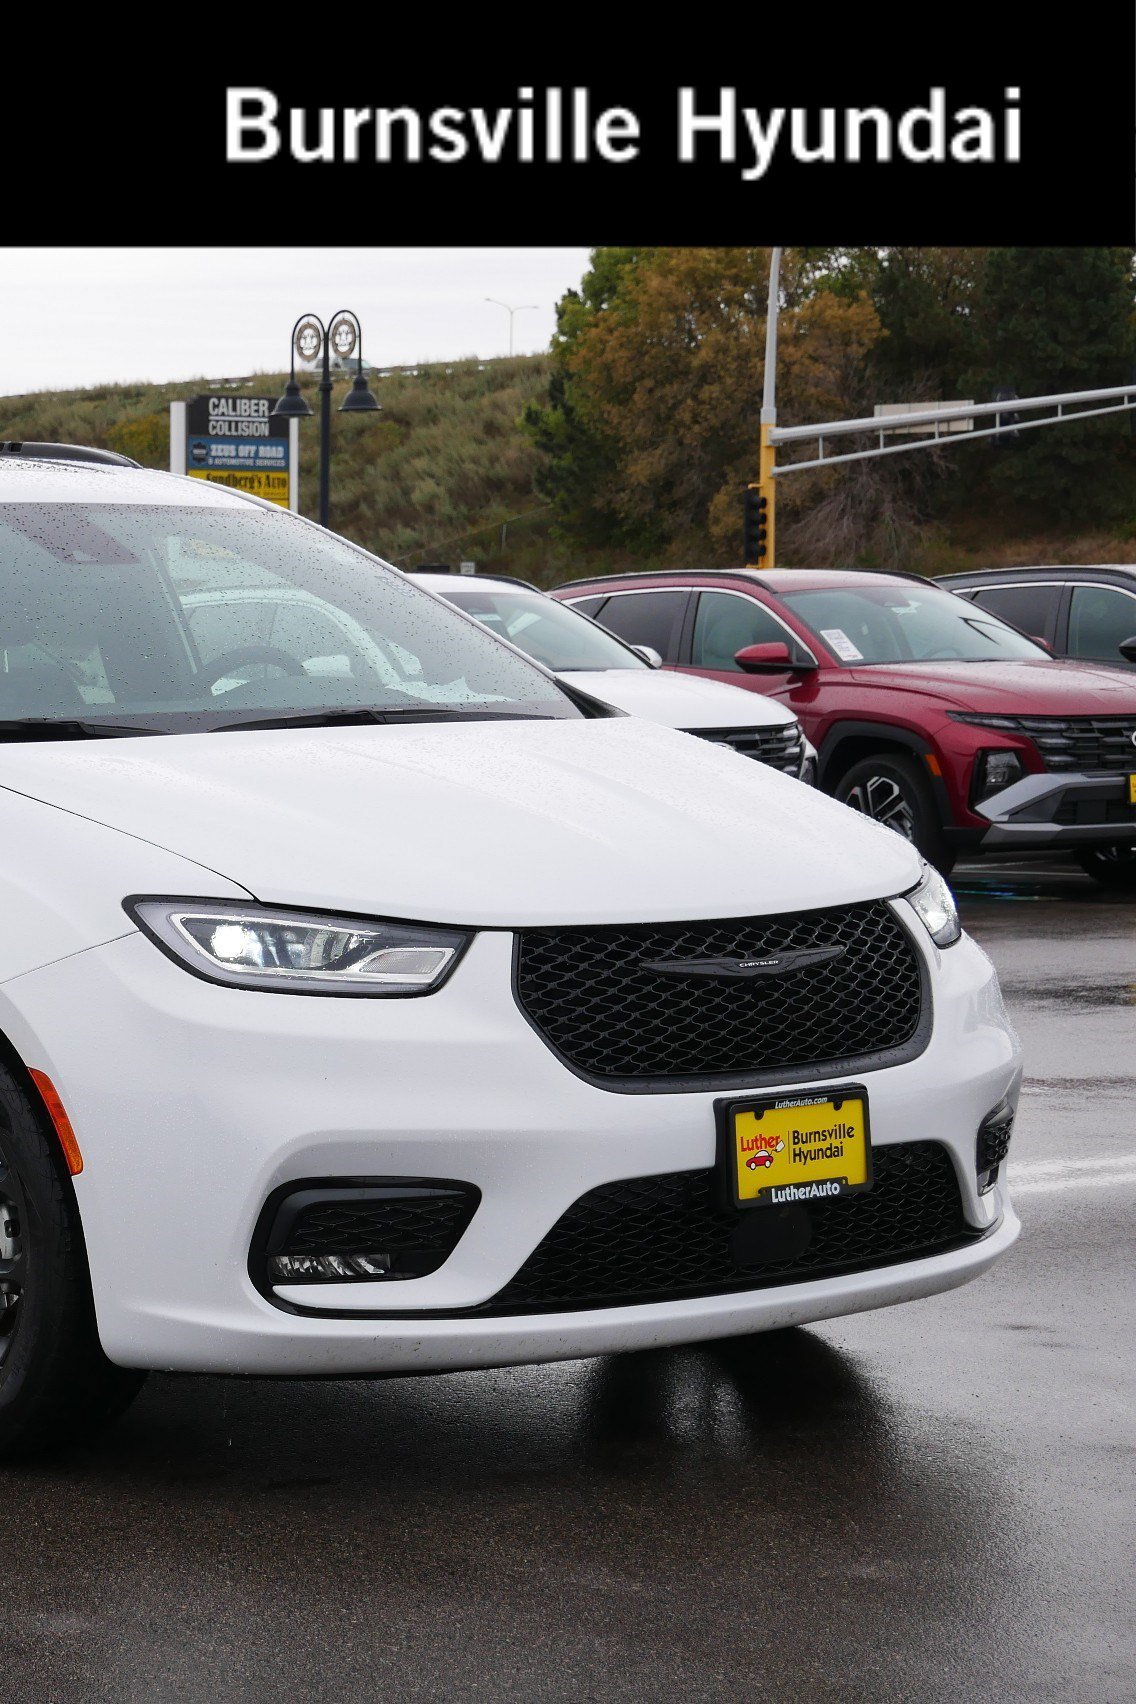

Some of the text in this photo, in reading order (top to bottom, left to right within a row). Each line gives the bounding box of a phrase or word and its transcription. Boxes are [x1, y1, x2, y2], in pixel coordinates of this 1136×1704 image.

[208, 398, 269, 417] CALIBER
[208, 421, 269, 436] COLLISION
[210, 445, 284, 458] ZEUS OFF ROAD
[255, 458, 285, 466] SERVICES
[774, 1096, 828, 1110] LutherAuto.com
[740, 1133, 781, 1152] Luther
[792, 1123, 856, 1146] Burnsville
[792, 1141, 845, 1166] Hyundai
[771, 1181, 841, 1203] LutherAuto
